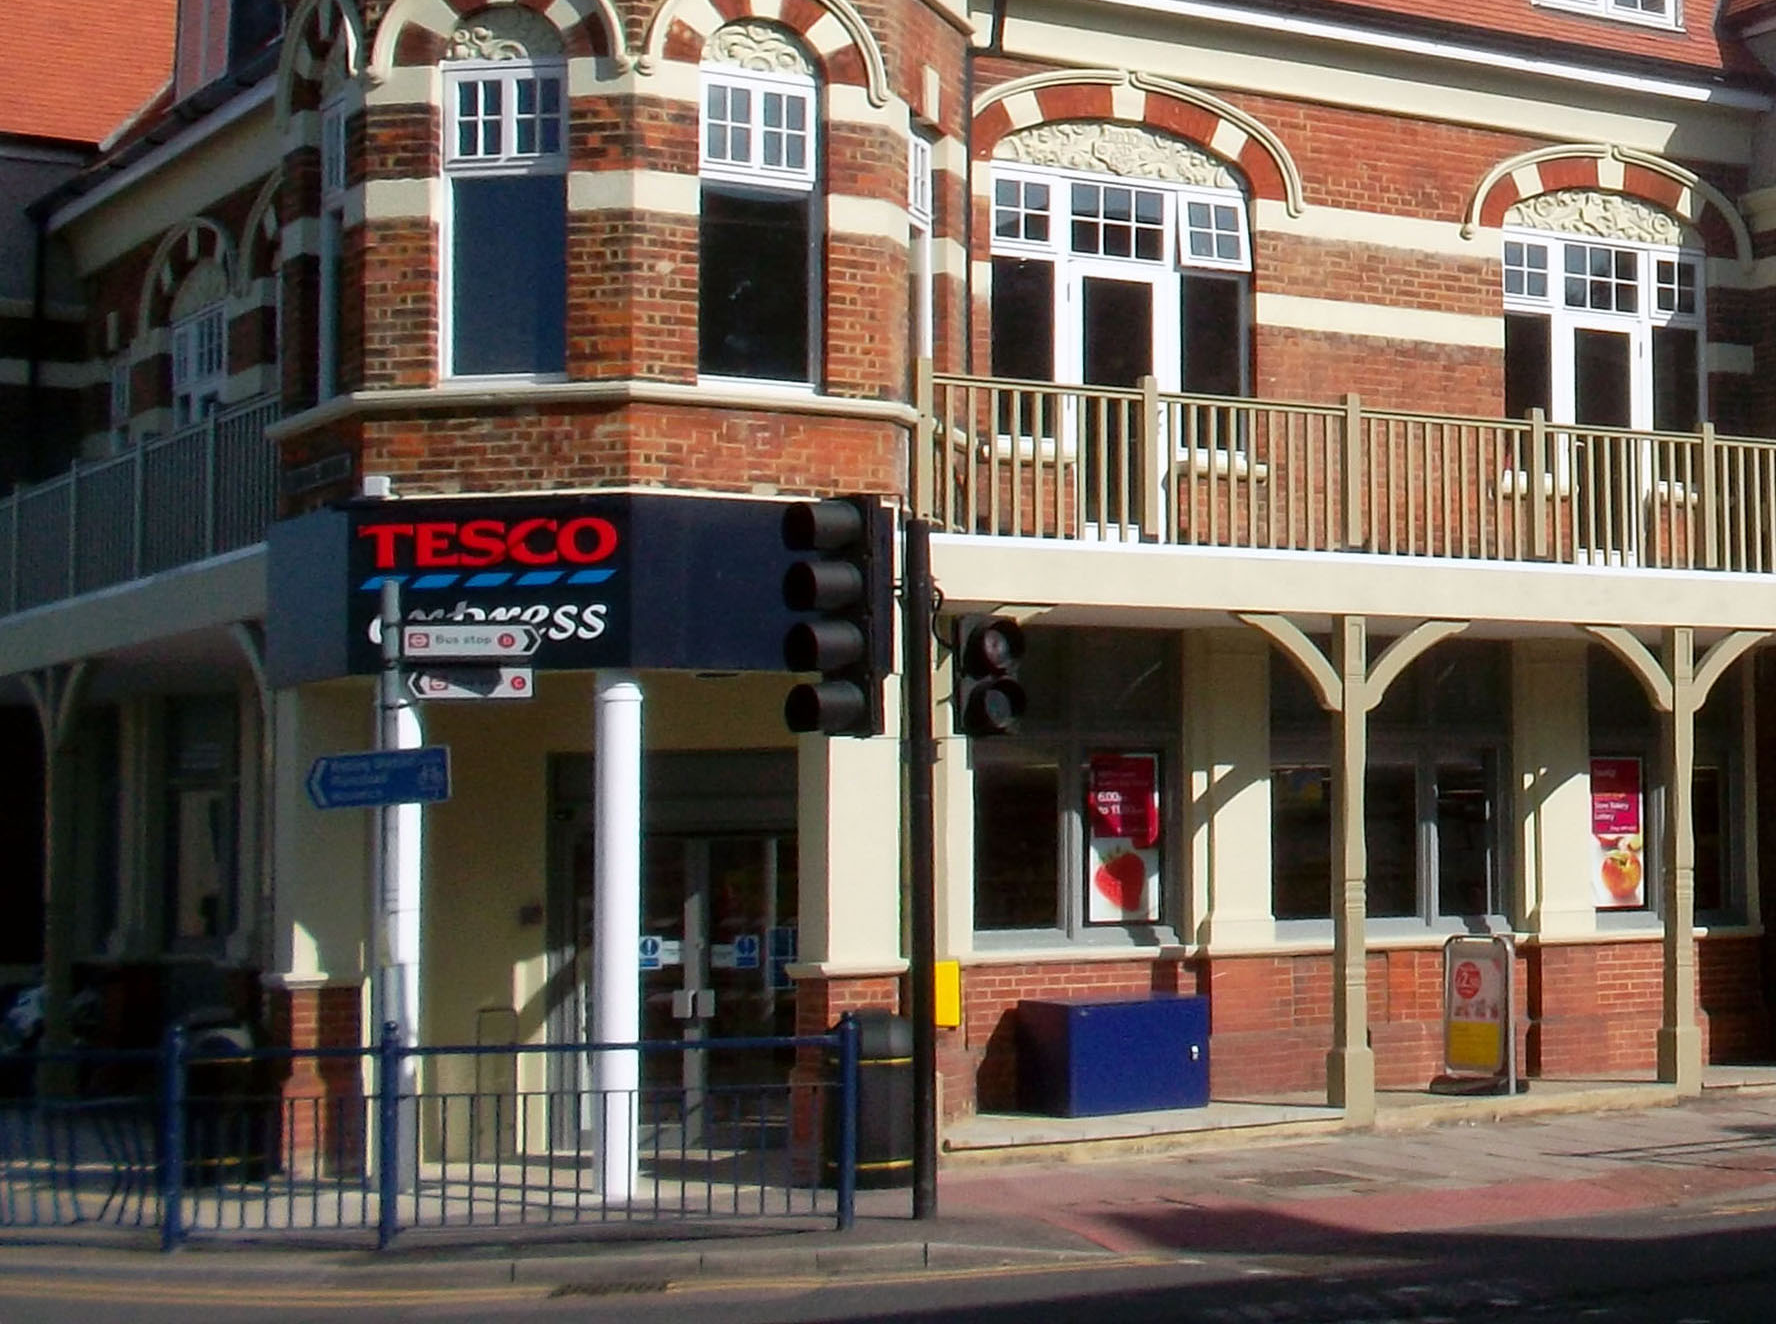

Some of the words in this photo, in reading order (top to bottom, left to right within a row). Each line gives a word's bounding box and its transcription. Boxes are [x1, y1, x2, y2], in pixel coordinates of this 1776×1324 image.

[357, 517, 618, 569] TESCO
[435, 633, 459, 645] Bus
[463, 634, 492, 646] stop
